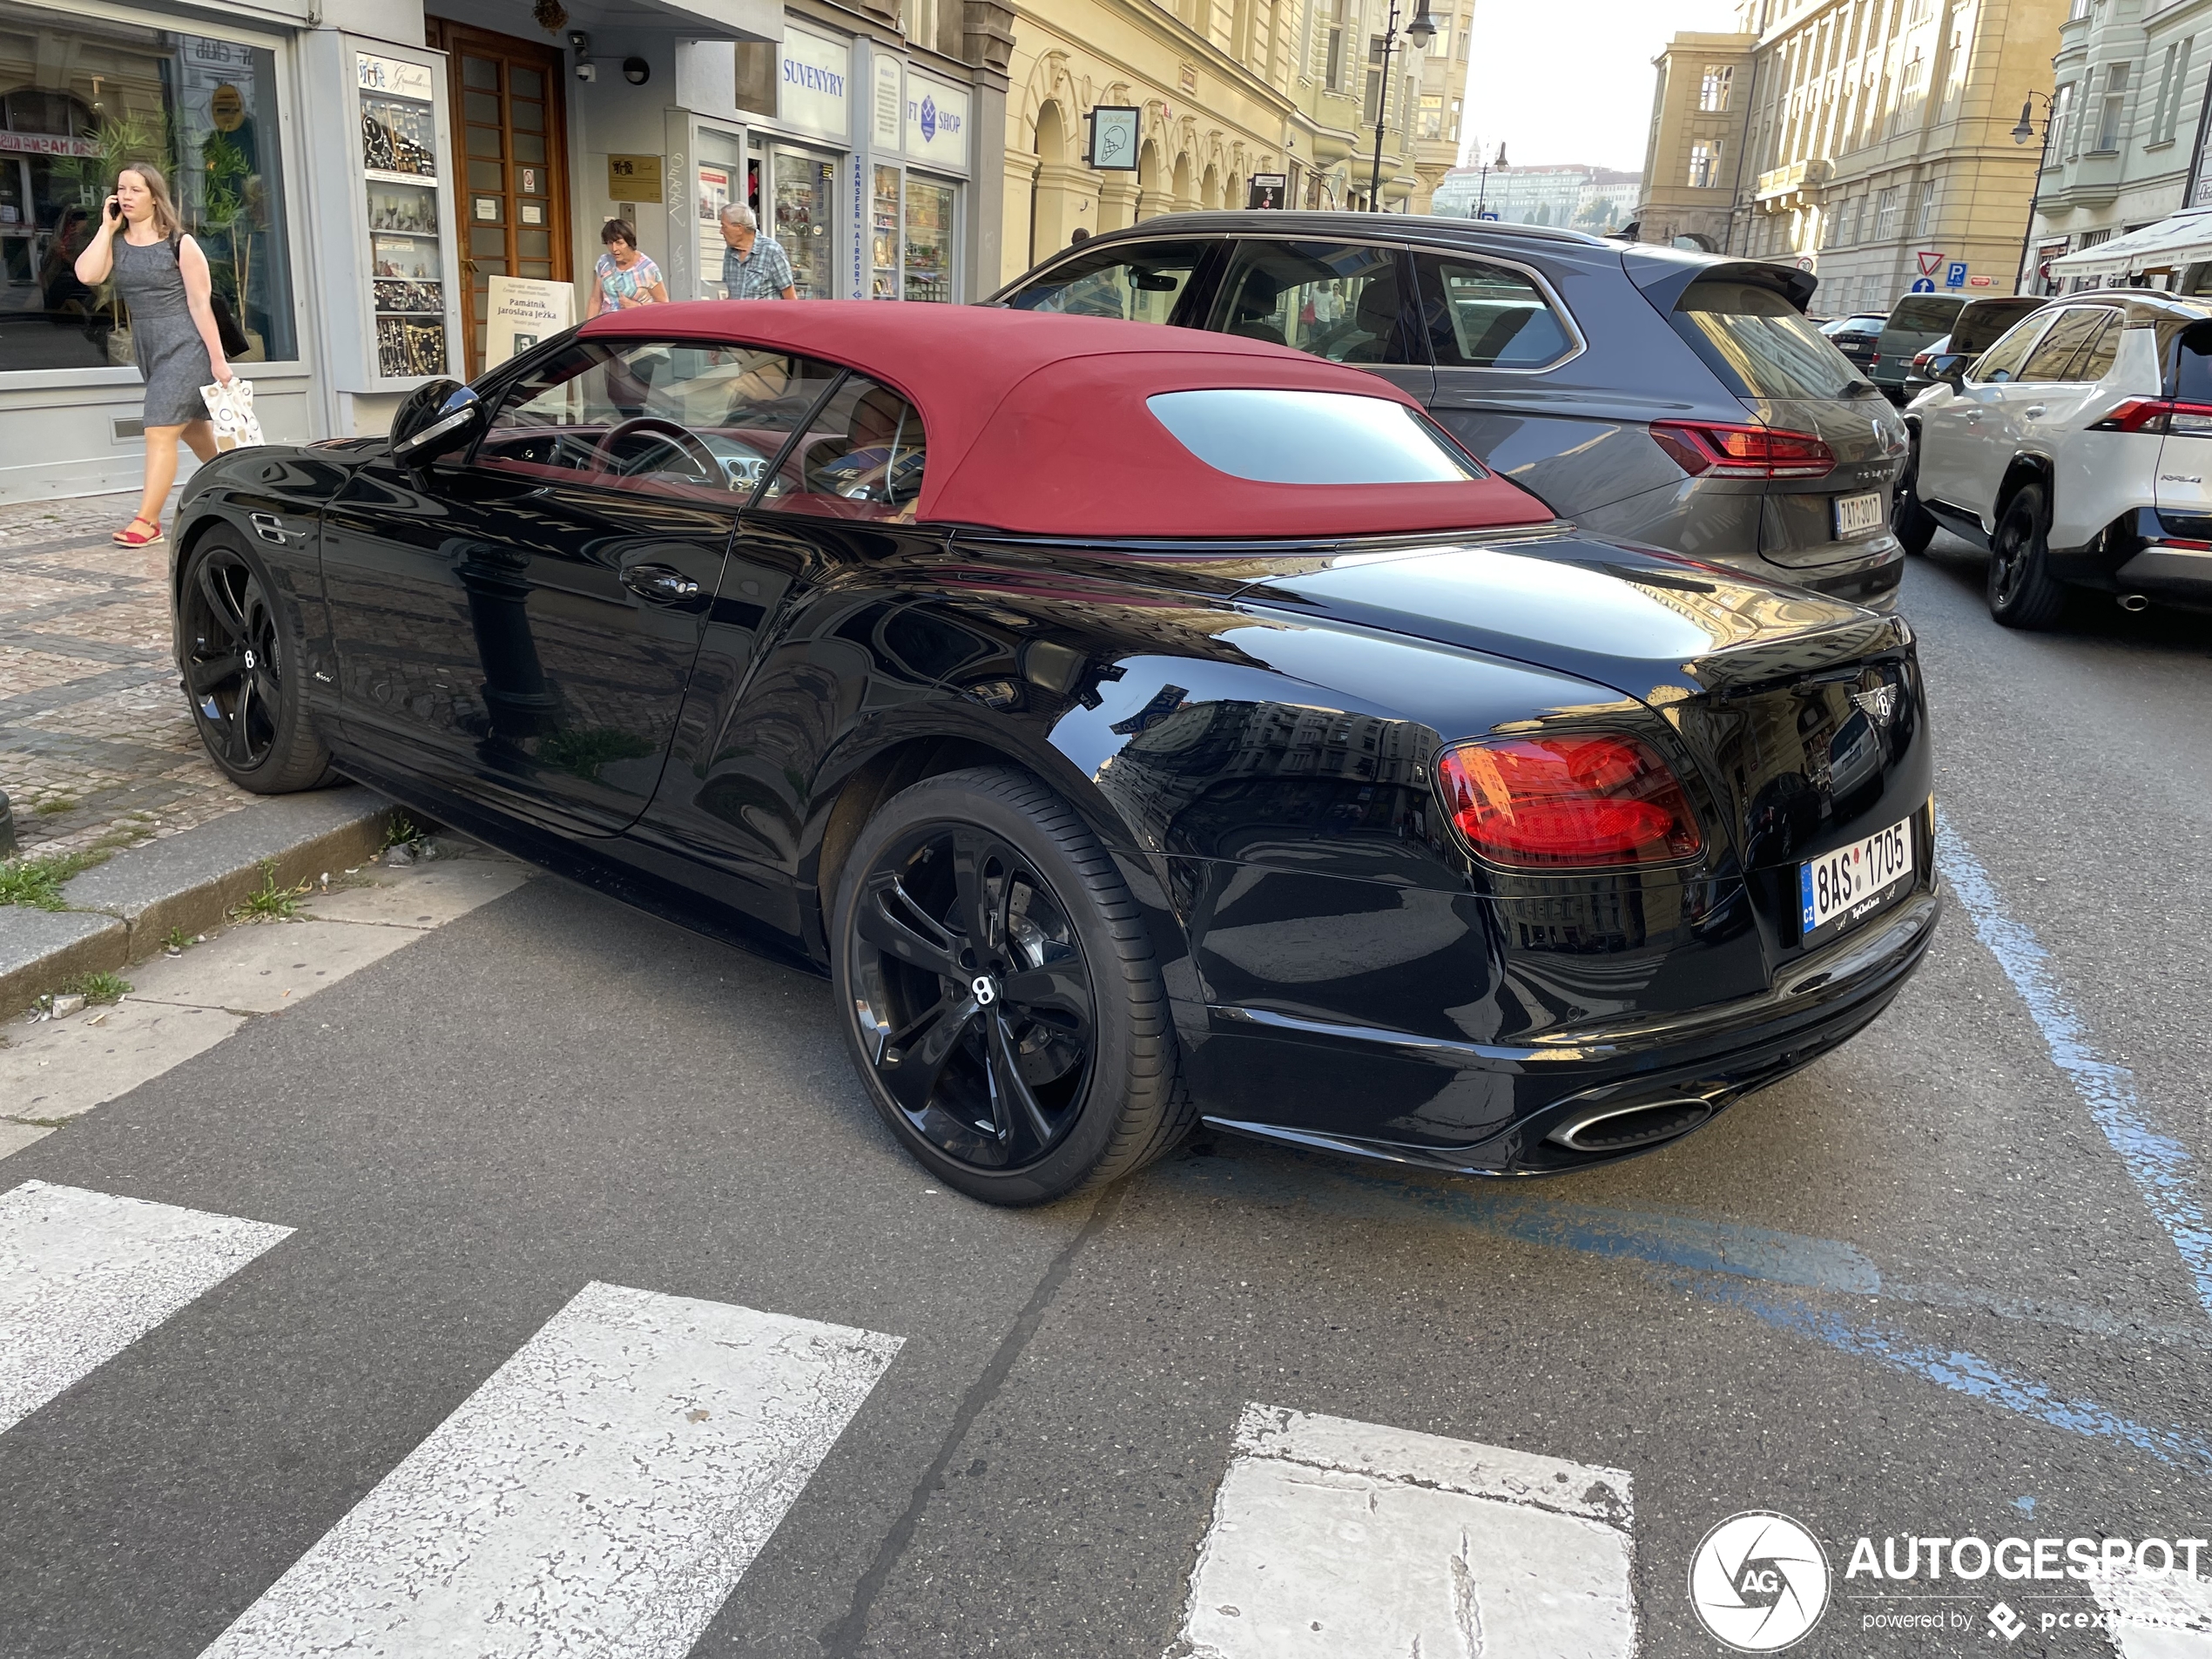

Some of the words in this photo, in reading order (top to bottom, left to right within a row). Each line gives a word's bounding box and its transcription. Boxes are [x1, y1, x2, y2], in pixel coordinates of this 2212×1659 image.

[783, 58, 844, 98] SUVENÝRY
[938, 111, 961, 133] SHOP
[1951, 265, 1964, 280] P
[497, 307, 534, 317] Jaroslava
[1842, 501, 1856, 529] 7AT
[1860, 497, 1878, 524] 3017
[1817, 852, 1851, 914] 8AS
[1865, 823, 1904, 887] 1705
[1804, 906, 1813, 924] CZ
